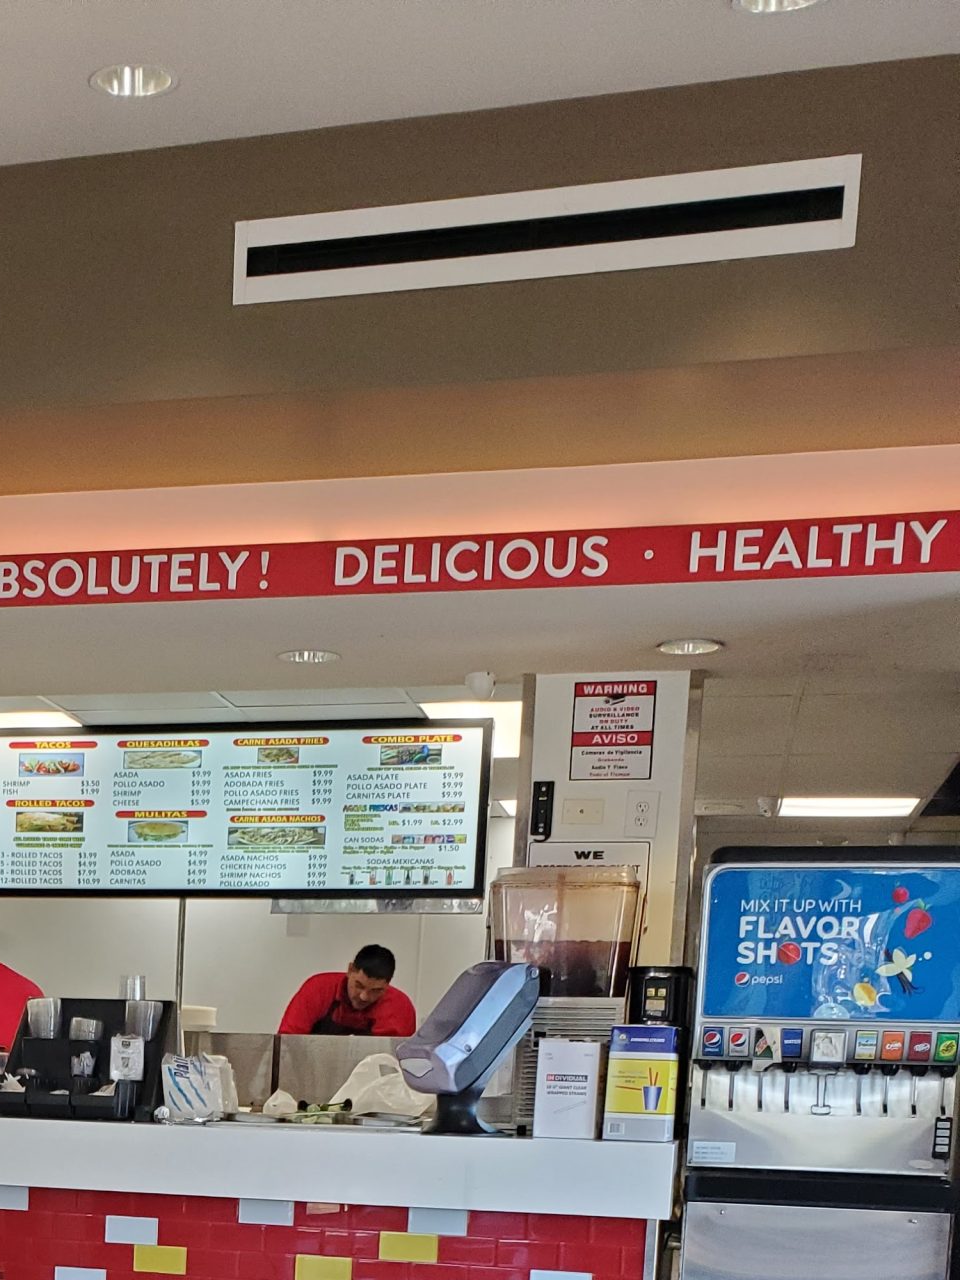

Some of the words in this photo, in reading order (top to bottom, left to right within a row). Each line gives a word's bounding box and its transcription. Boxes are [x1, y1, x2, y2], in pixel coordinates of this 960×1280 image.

[334, 535, 609, 586] DELICIOUS
[688, 519, 948, 573] HEALTHY
[583, 684, 648, 695] WARNING
[127, 740, 201, 748] QUESADILLAS
[592, 733, 638, 744] AVISO
[261, 815, 288, 823] ASADA
[574, 850, 605, 860] WE
[740, 899, 770, 913] MIX
[774, 899, 790, 913] IT
[793, 899, 816, 913] UP
[818, 899, 862, 913] WITH
[739, 915, 860, 939] FLAVOR
[751, 974, 783, 987] pepsi
[547, 1074, 587, 1082] INDIVIDUAL
